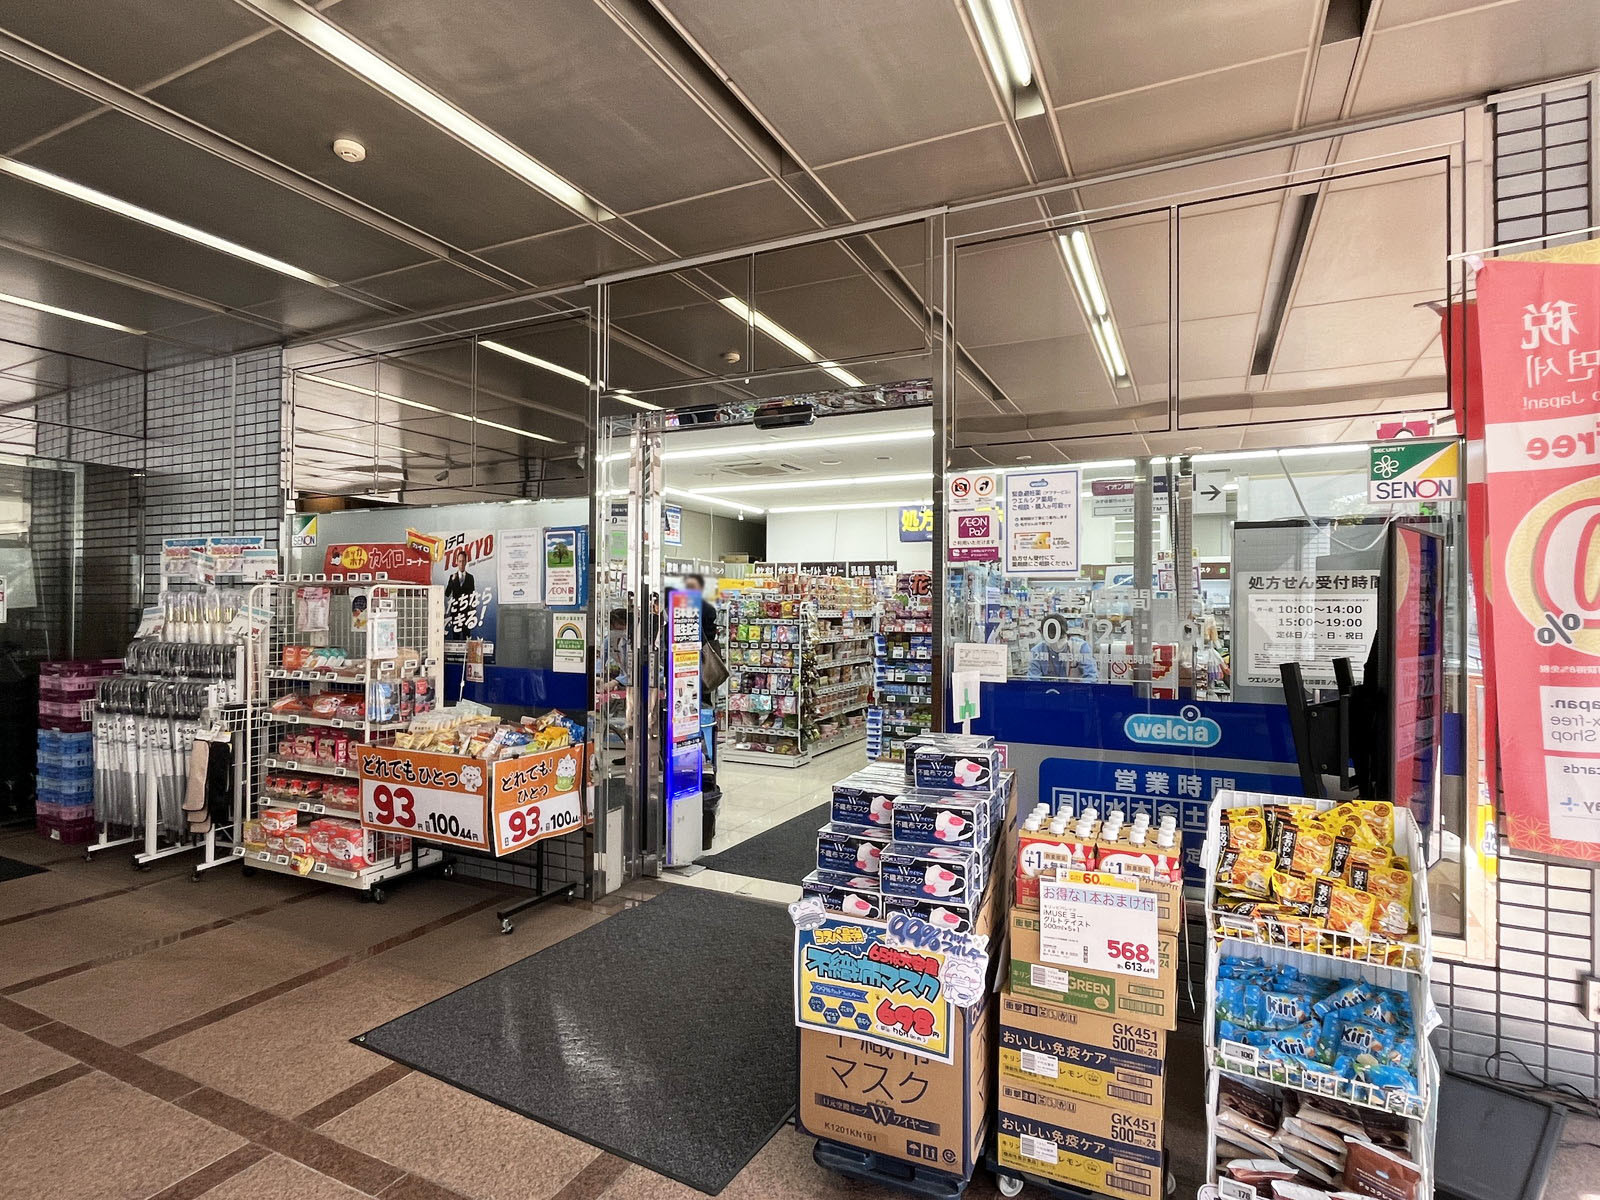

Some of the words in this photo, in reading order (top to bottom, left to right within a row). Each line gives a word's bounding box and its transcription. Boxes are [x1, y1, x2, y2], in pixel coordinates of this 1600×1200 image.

[1376, 479, 1451, 500] SENON
[969, 527, 987, 537] Pay
[369, 548, 404, 569] カイロ
[406, 558, 429, 566] コーナー
[444, 534, 494, 571] TOKYO
[1133, 720, 1209, 742] welcia
[362, 755, 416, 781] どれでも
[419, 768, 459, 786] ひとつ
[501, 758, 553, 792] どれでも!
[517, 785, 549, 803] ひとつ
[1114, 769, 1235, 799] 営業時間
[1083, 872, 1101, 885] 60
[1043, 887, 1155, 912] お得な1本おまけ付
[1043, 910, 1068, 918] iMUSE
[1070, 911, 1084, 919] ヨー
[1043, 916, 1091, 928] グルトテイスト
[888, 914, 942, 952] 99%
[806, 946, 941, 1003] 不織布マスク
[1012, 970, 1030, 980] キリン
[1067, 976, 1111, 997] GREEN
[1267, 996, 1297, 1016] Kiri
[1112, 1023, 1158, 1042] GK451
[1342, 1026, 1372, 1047] Kiri
[1003, 1030, 1108, 1064] おいしい免疫ケア
[825, 1055, 929, 1104] マスク
[824, 1121, 878, 1143] K1201KN101
[893, 1115, 930, 1131] ワイヤー
[1111, 1113, 1157, 1133] GK451
[1002, 1117, 1107, 1155] おいしい免疫ケア
